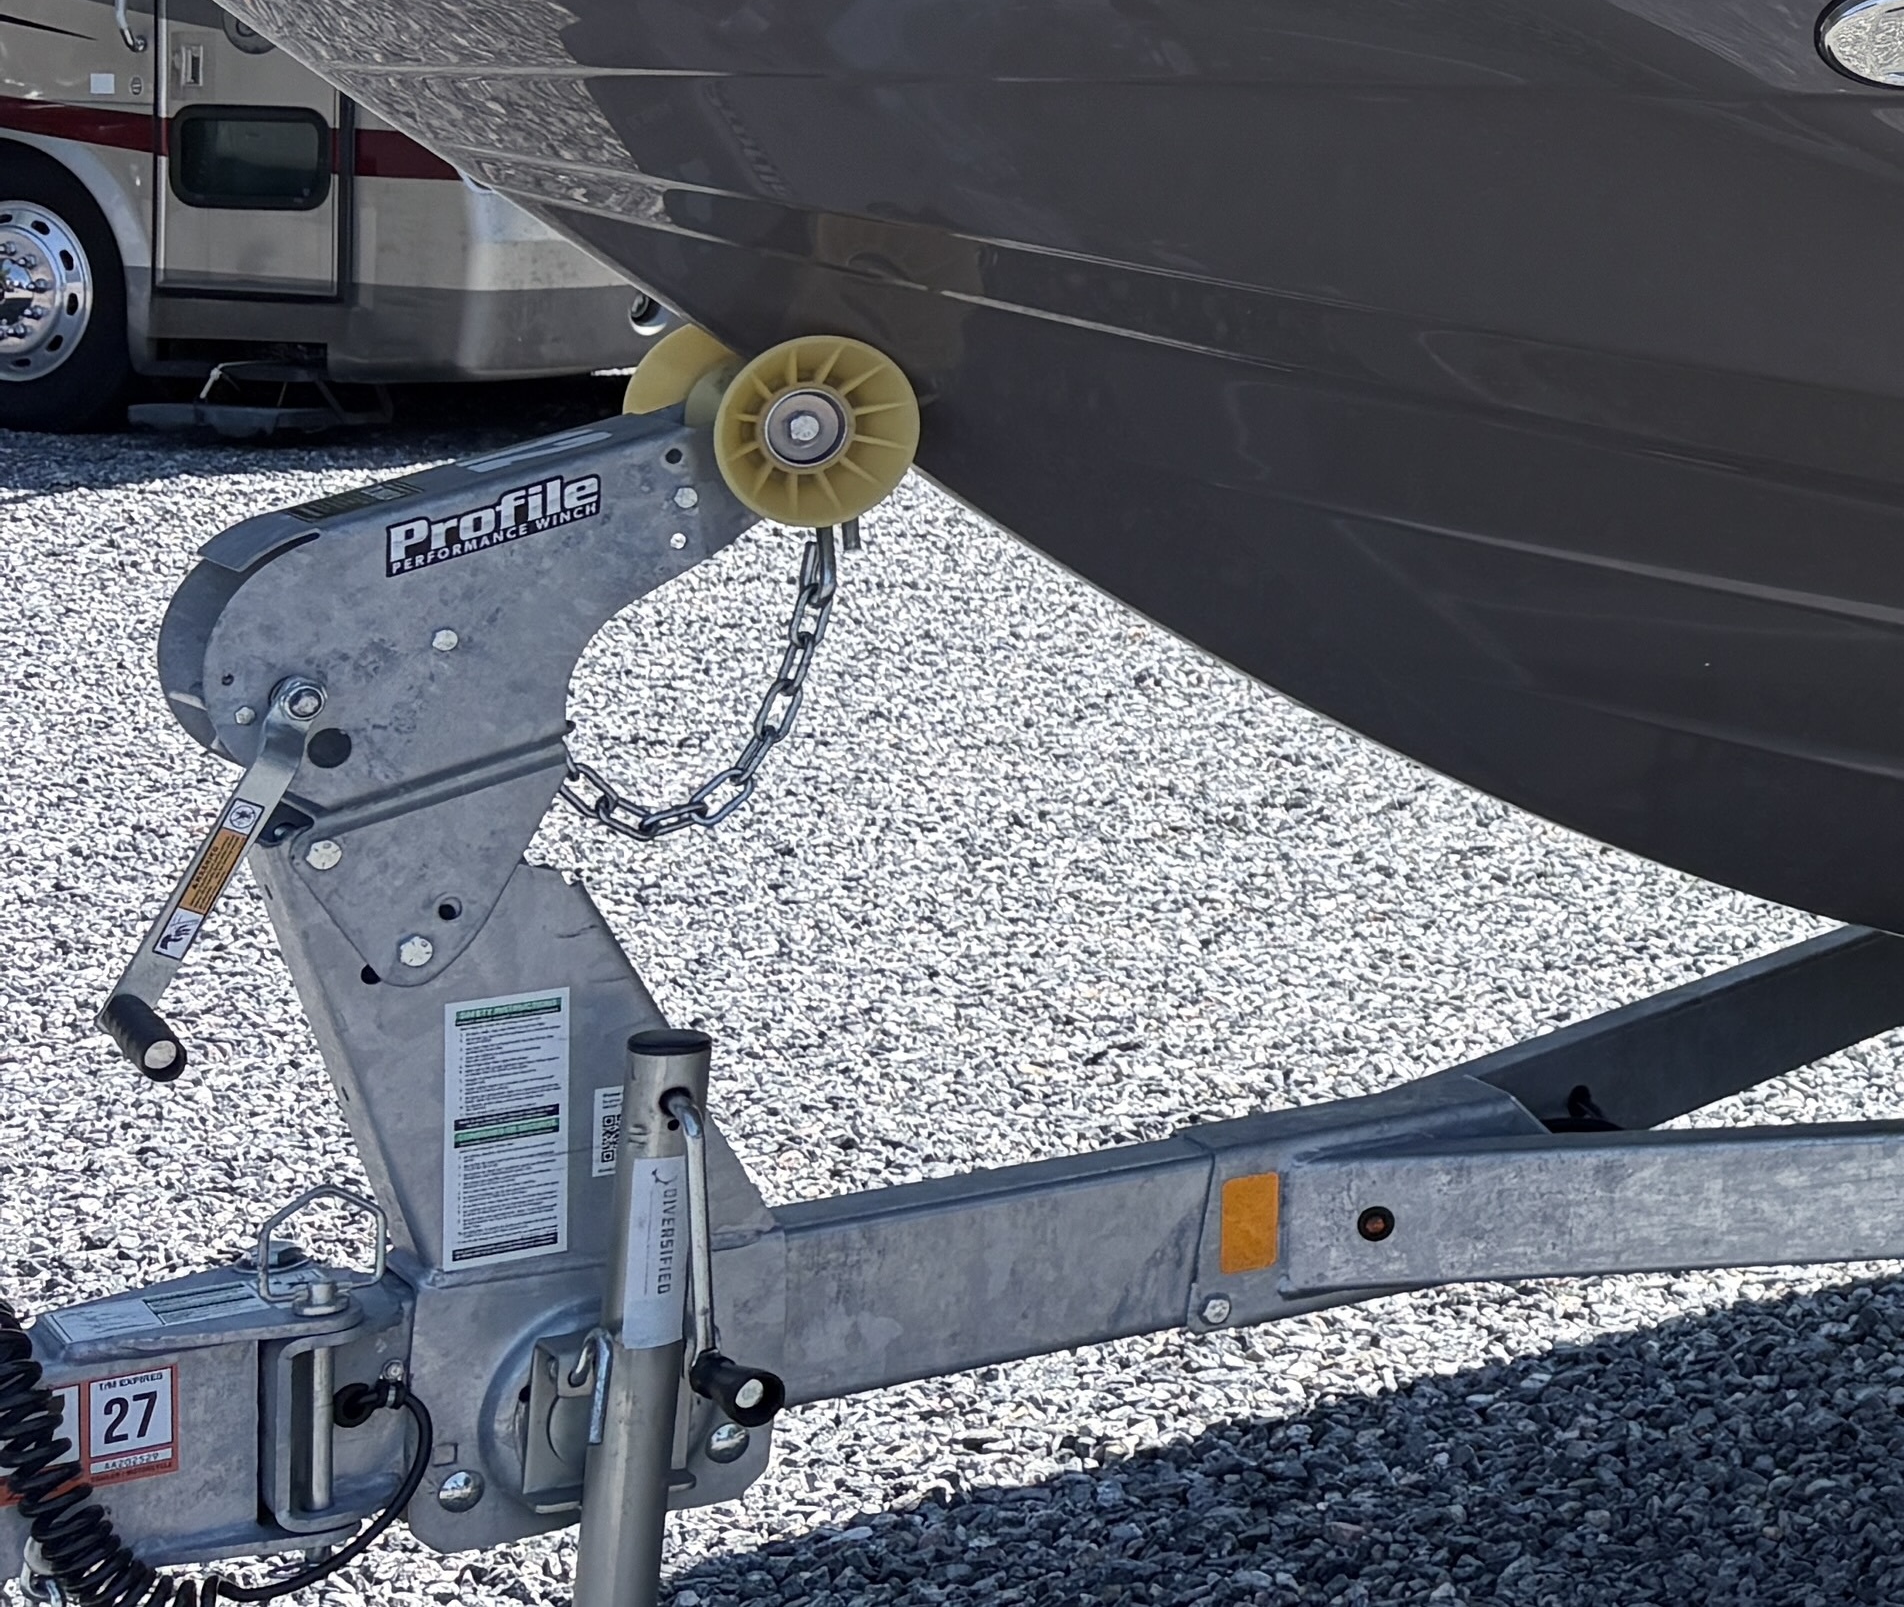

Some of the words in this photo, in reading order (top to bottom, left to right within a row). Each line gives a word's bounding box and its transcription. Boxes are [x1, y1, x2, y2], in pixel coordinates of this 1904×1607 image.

[390, 477, 599, 563] Profile
[392, 524, 528, 574] PERFORMANCE
[535, 502, 598, 531] WINCH
[657, 1188, 678, 1295] DIVERSIFIED
[103, 1390, 158, 1445] 27
